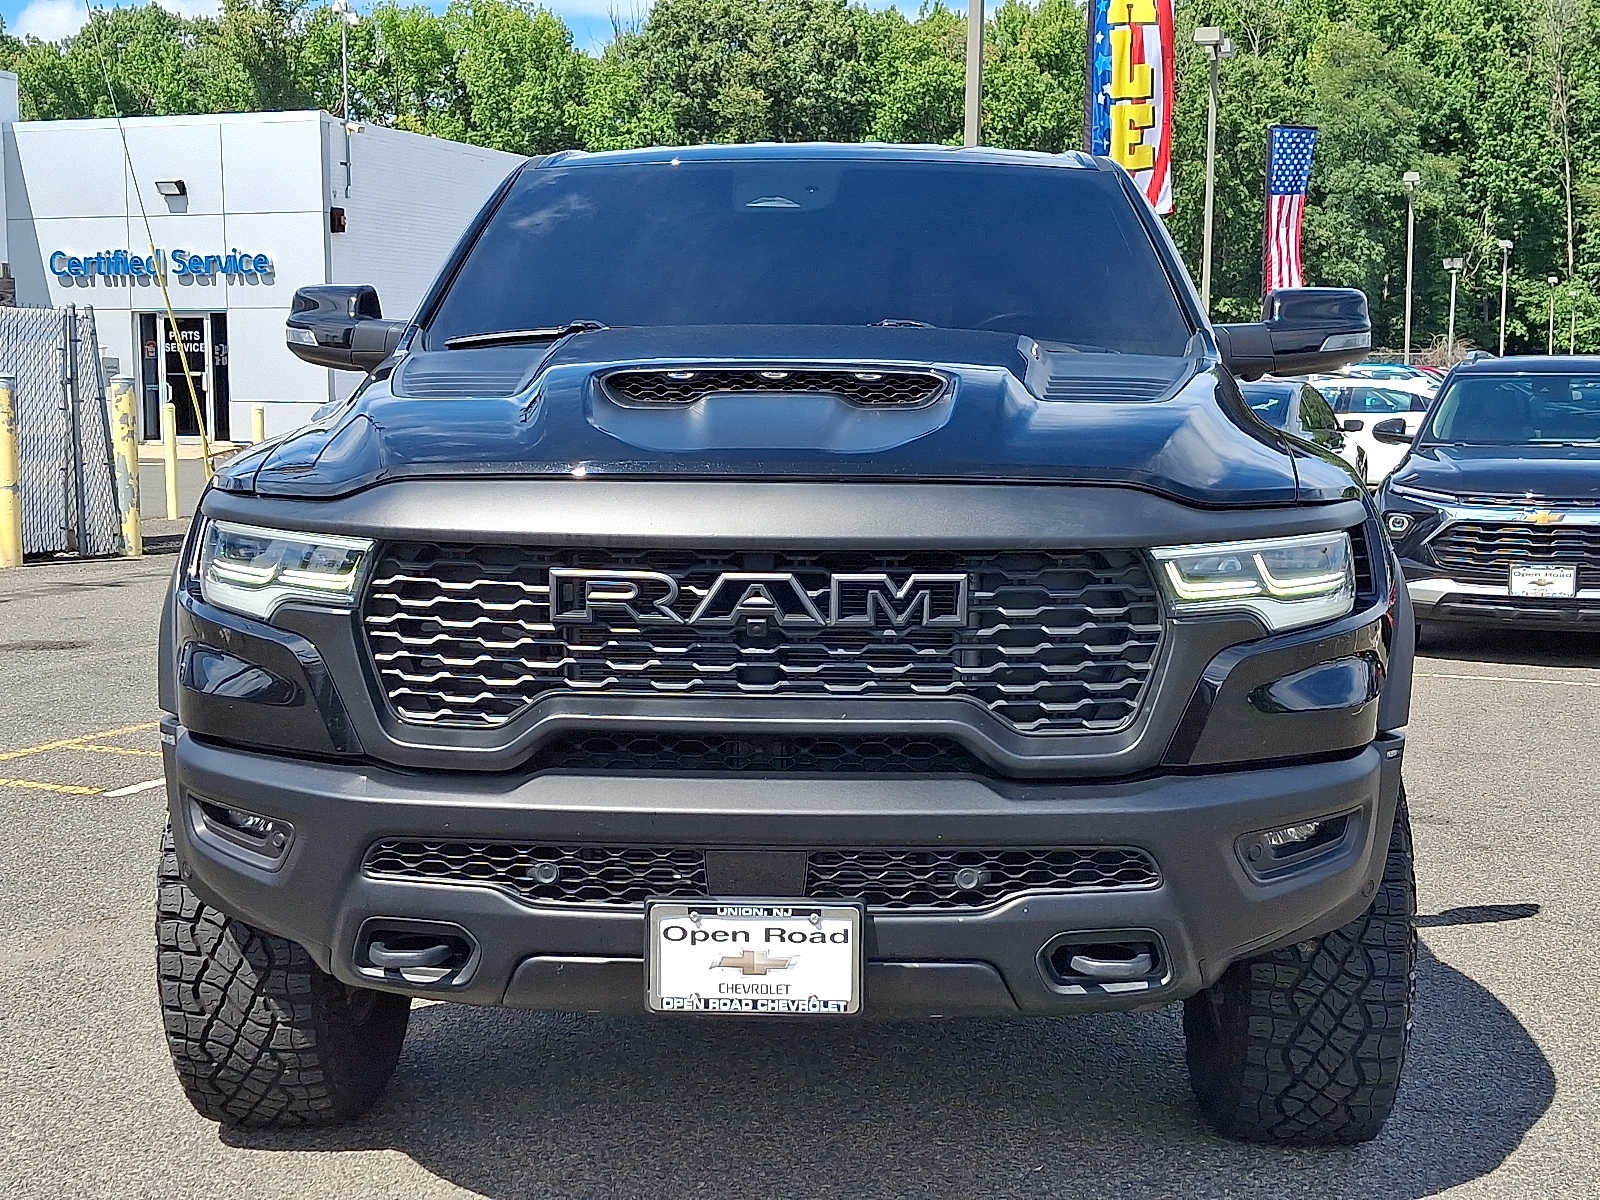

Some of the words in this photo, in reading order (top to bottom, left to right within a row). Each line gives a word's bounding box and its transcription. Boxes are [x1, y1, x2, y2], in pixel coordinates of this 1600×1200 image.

[50, 249, 161, 276] Certified
[171, 248, 269, 275] Service
[168, 331, 200, 341] PRTS
[549, 567, 968, 626] RAM
[717, 907, 769, 917] UNION,
[773, 908, 793, 917] NJ
[663, 925, 750, 946] Open
[764, 927, 849, 944] Road
[718, 982, 792, 995] CHEVROLET
[661, 997, 706, 1011] OPEN
[710, 999, 755, 1012] ROAD
[758, 1000, 849, 1013] CHEVROLET
